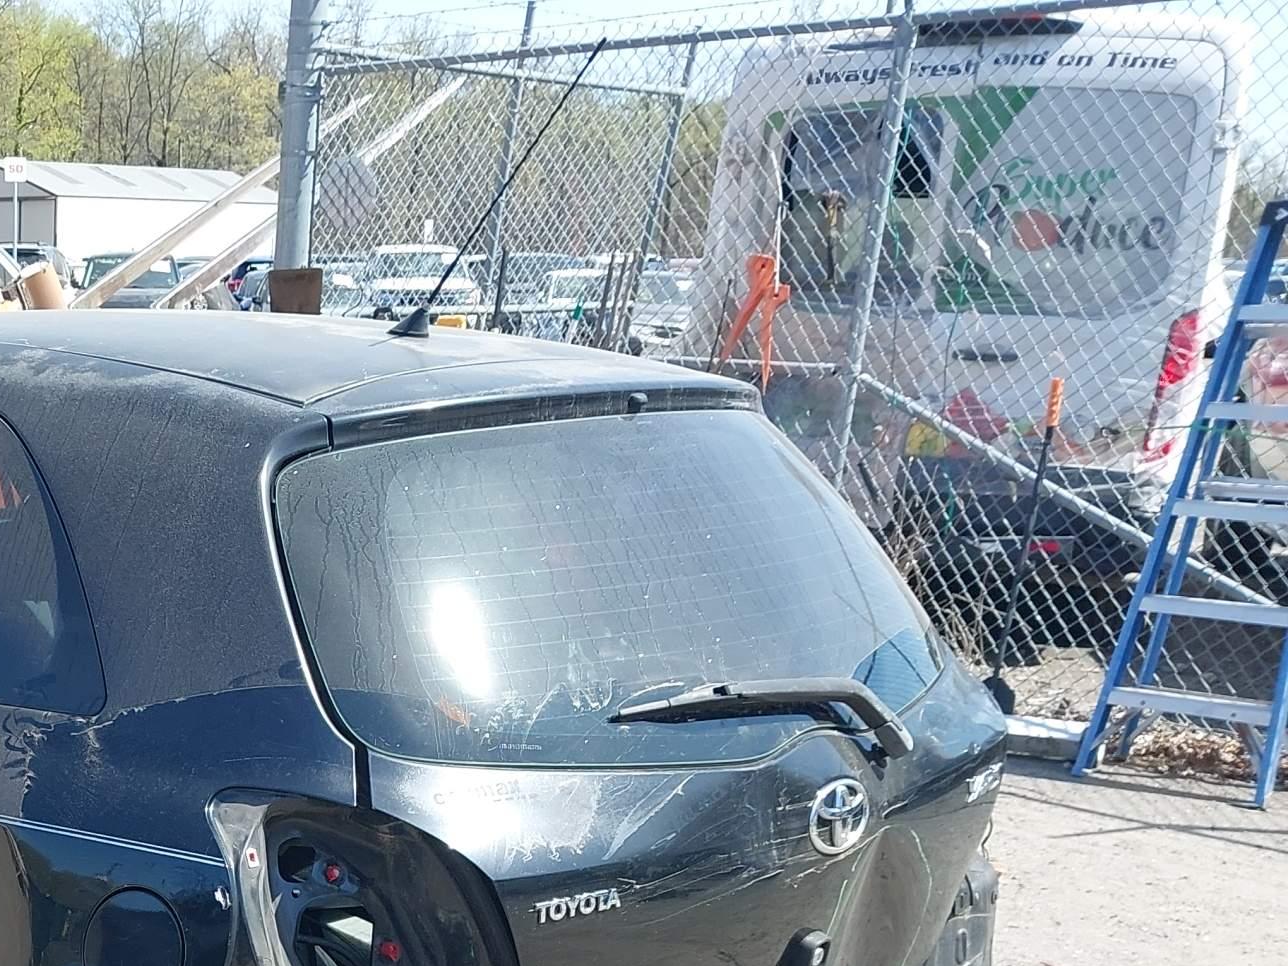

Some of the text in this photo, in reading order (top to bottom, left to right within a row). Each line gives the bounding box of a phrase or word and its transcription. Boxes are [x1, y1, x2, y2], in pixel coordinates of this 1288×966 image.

[993, 51, 1049, 66] and
[1057, 53, 1093, 66] on
[1106, 51, 1178, 70] Time
[534, 887, 621, 923] TOYOTA
